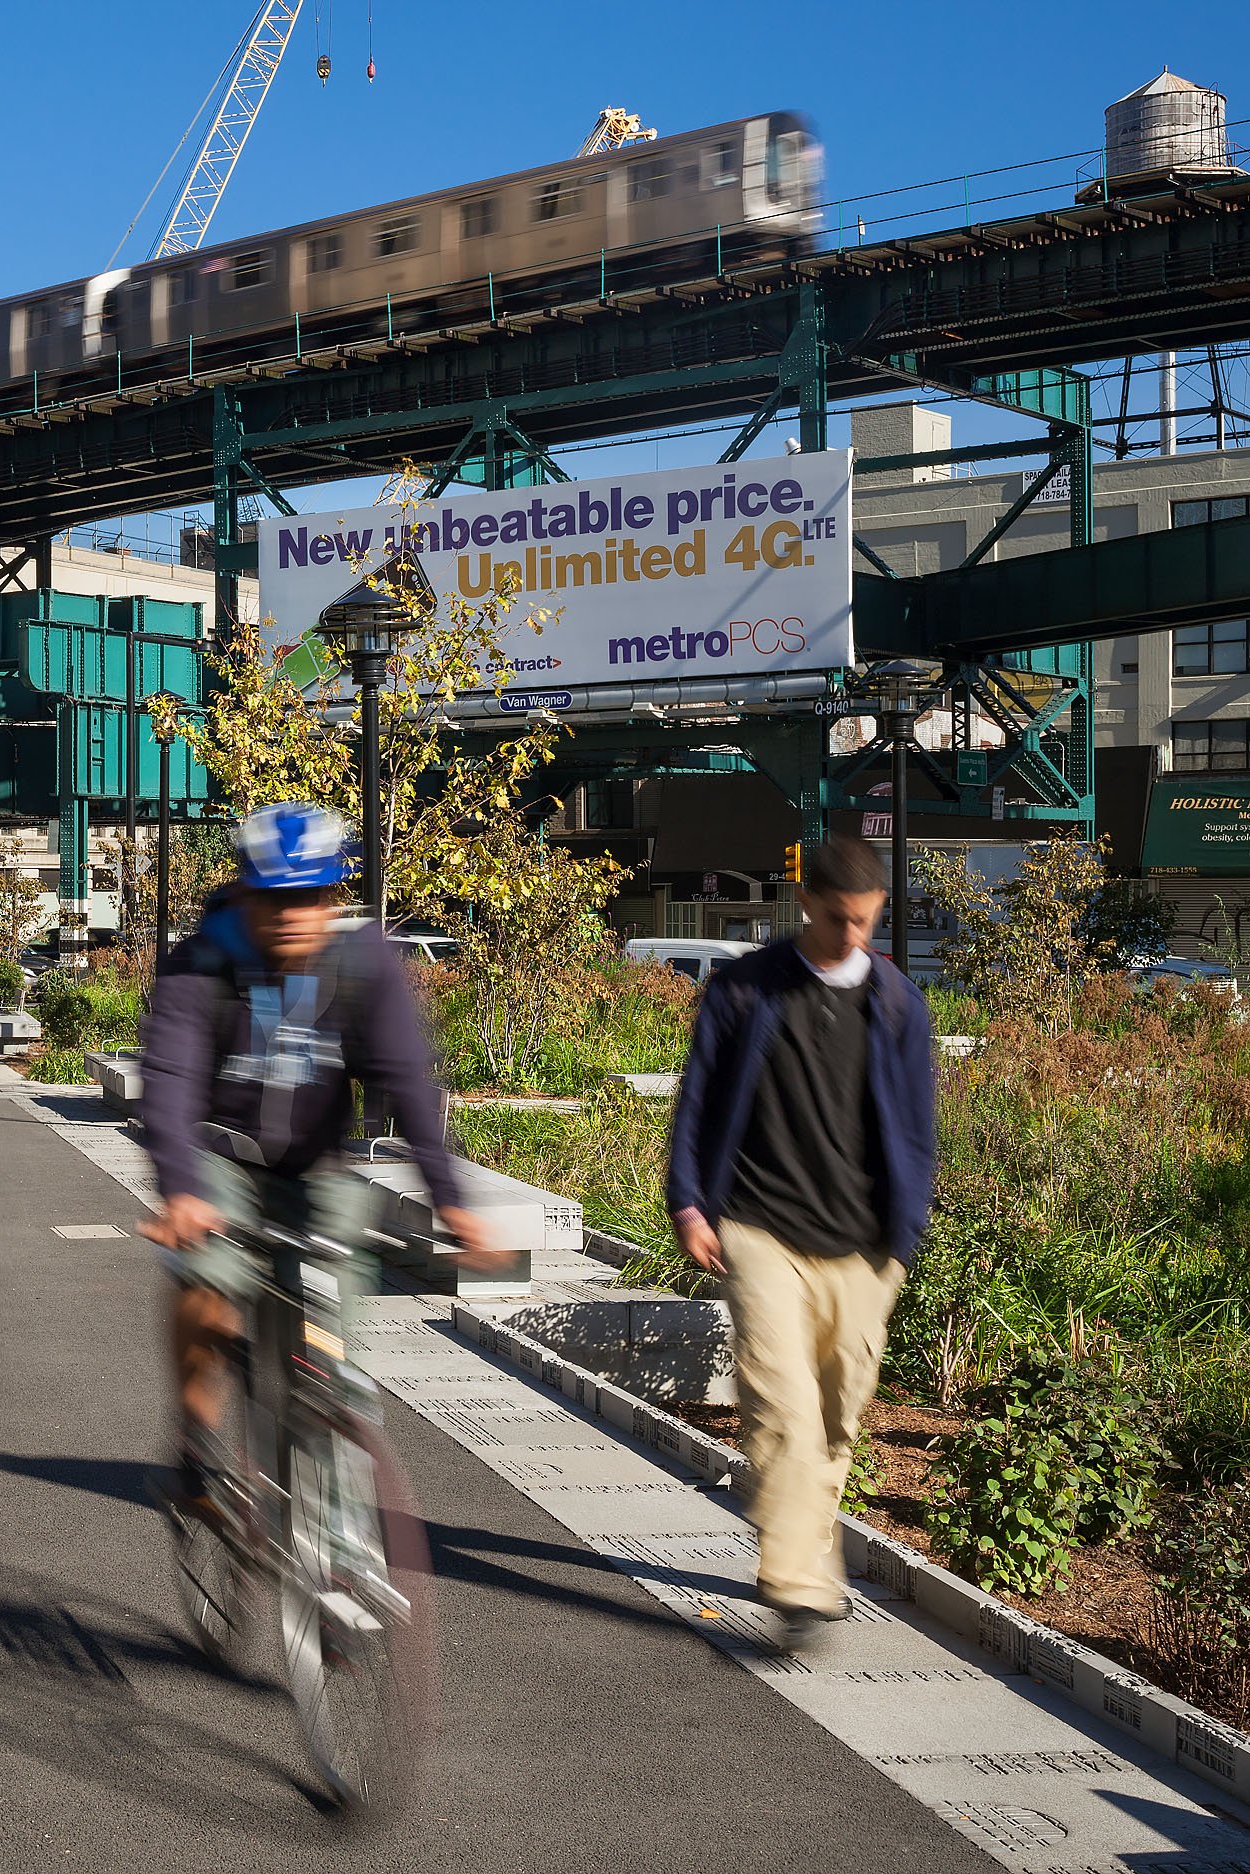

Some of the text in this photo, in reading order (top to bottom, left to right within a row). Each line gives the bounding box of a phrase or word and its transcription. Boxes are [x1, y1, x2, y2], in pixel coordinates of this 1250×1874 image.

[278, 473, 814, 569] New unbeatable price.
[457, 516, 836, 599] Unlimited 4G. LTE
[608, 616, 806, 665] metroPCS
[507, 695, 567, 708] Van Wagner
[815, 700, 849, 715] Q-9140
[1169, 797, 1245, 810] HOLISTIC
[1204, 822, 1238, 832] Support
[1201, 833, 1234, 842] obesity,
